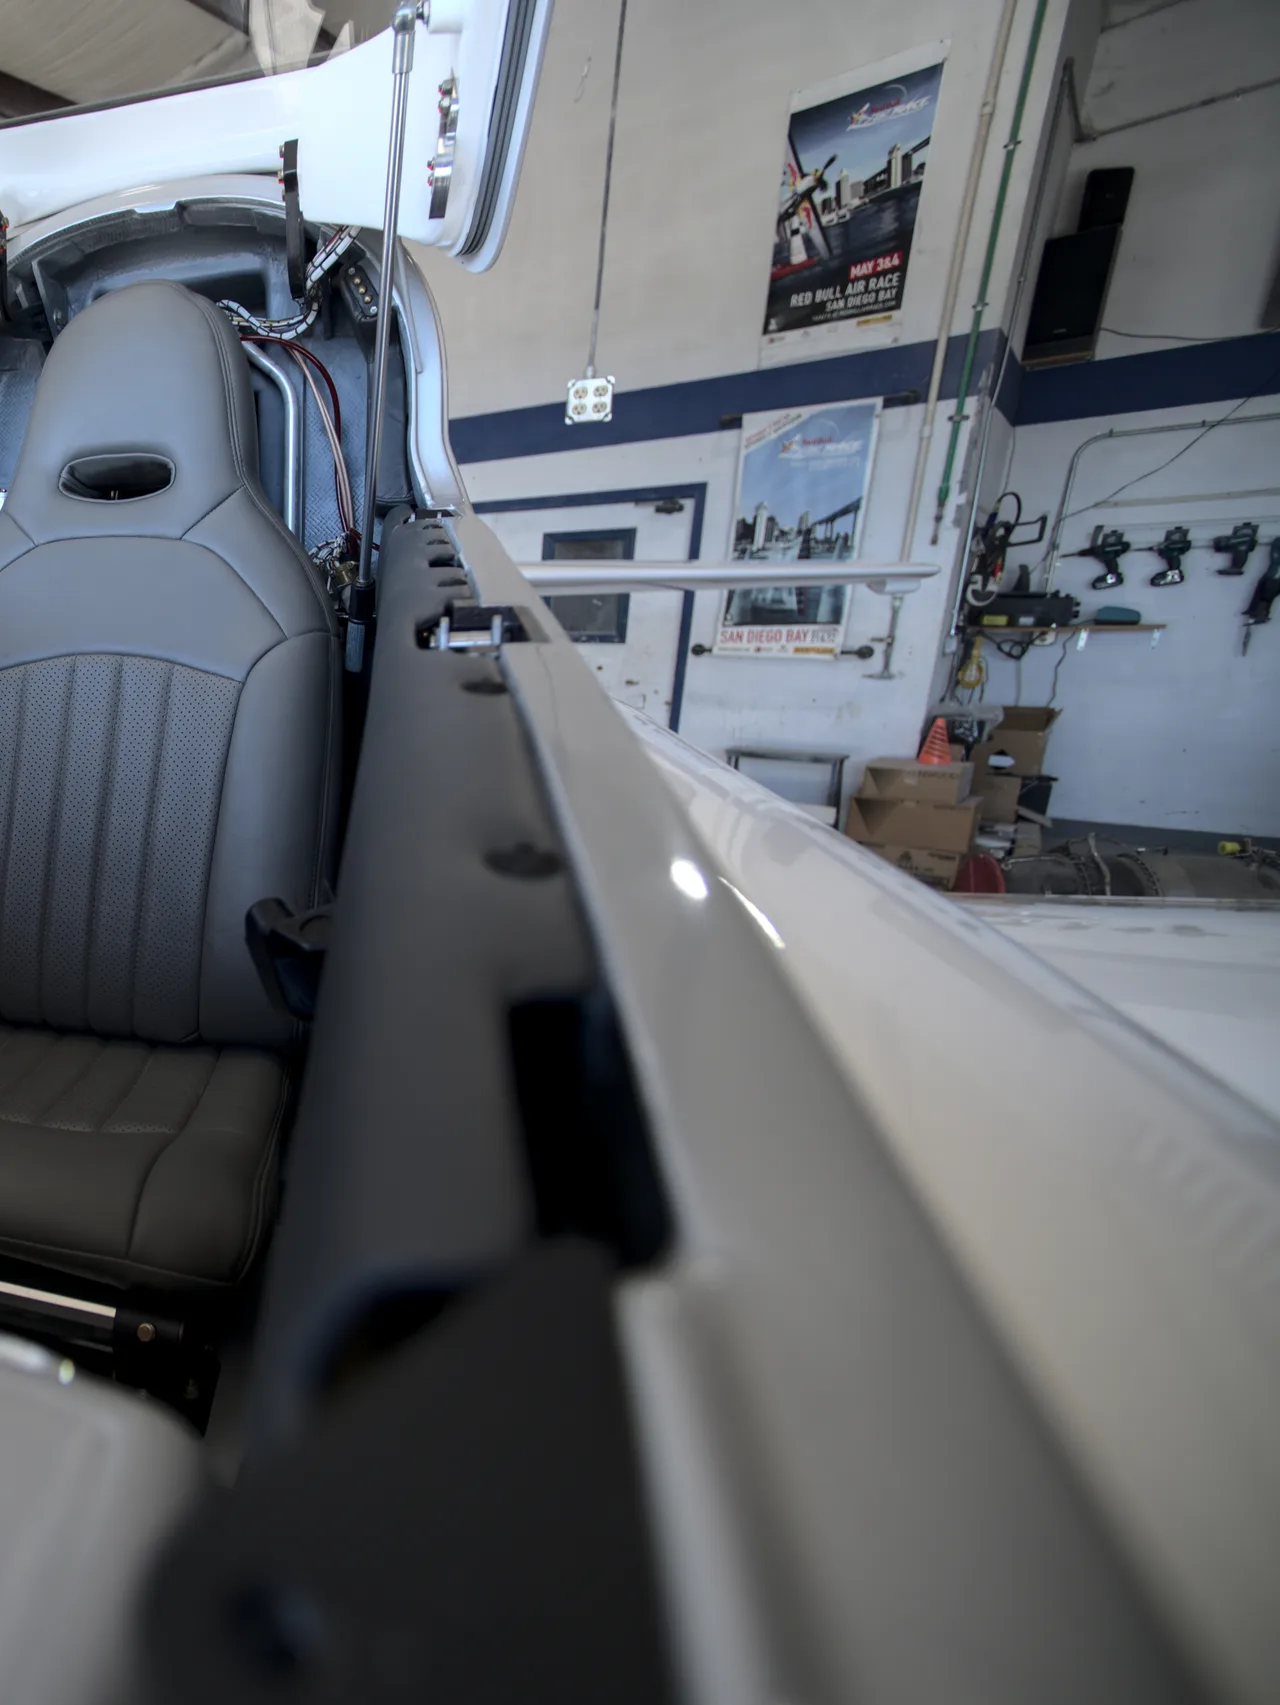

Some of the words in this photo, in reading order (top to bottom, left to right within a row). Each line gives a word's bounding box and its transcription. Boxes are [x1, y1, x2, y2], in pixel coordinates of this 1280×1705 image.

[850, 261, 875, 279] MAY
[876, 253, 900, 271] 3&4
[790, 291, 813, 308] RED
[814, 285, 842, 302] BULL
[844, 280, 867, 296] AIR
[868, 272, 900, 293] RACE
[825, 299, 845, 312] SAN
[847, 293, 876, 308] DIEGO
[877, 288, 897, 302] BAY
[720, 629, 744, 643] SAN
[746, 629, 783, 643] DIEGO
[785, 629, 809, 643] BAY
